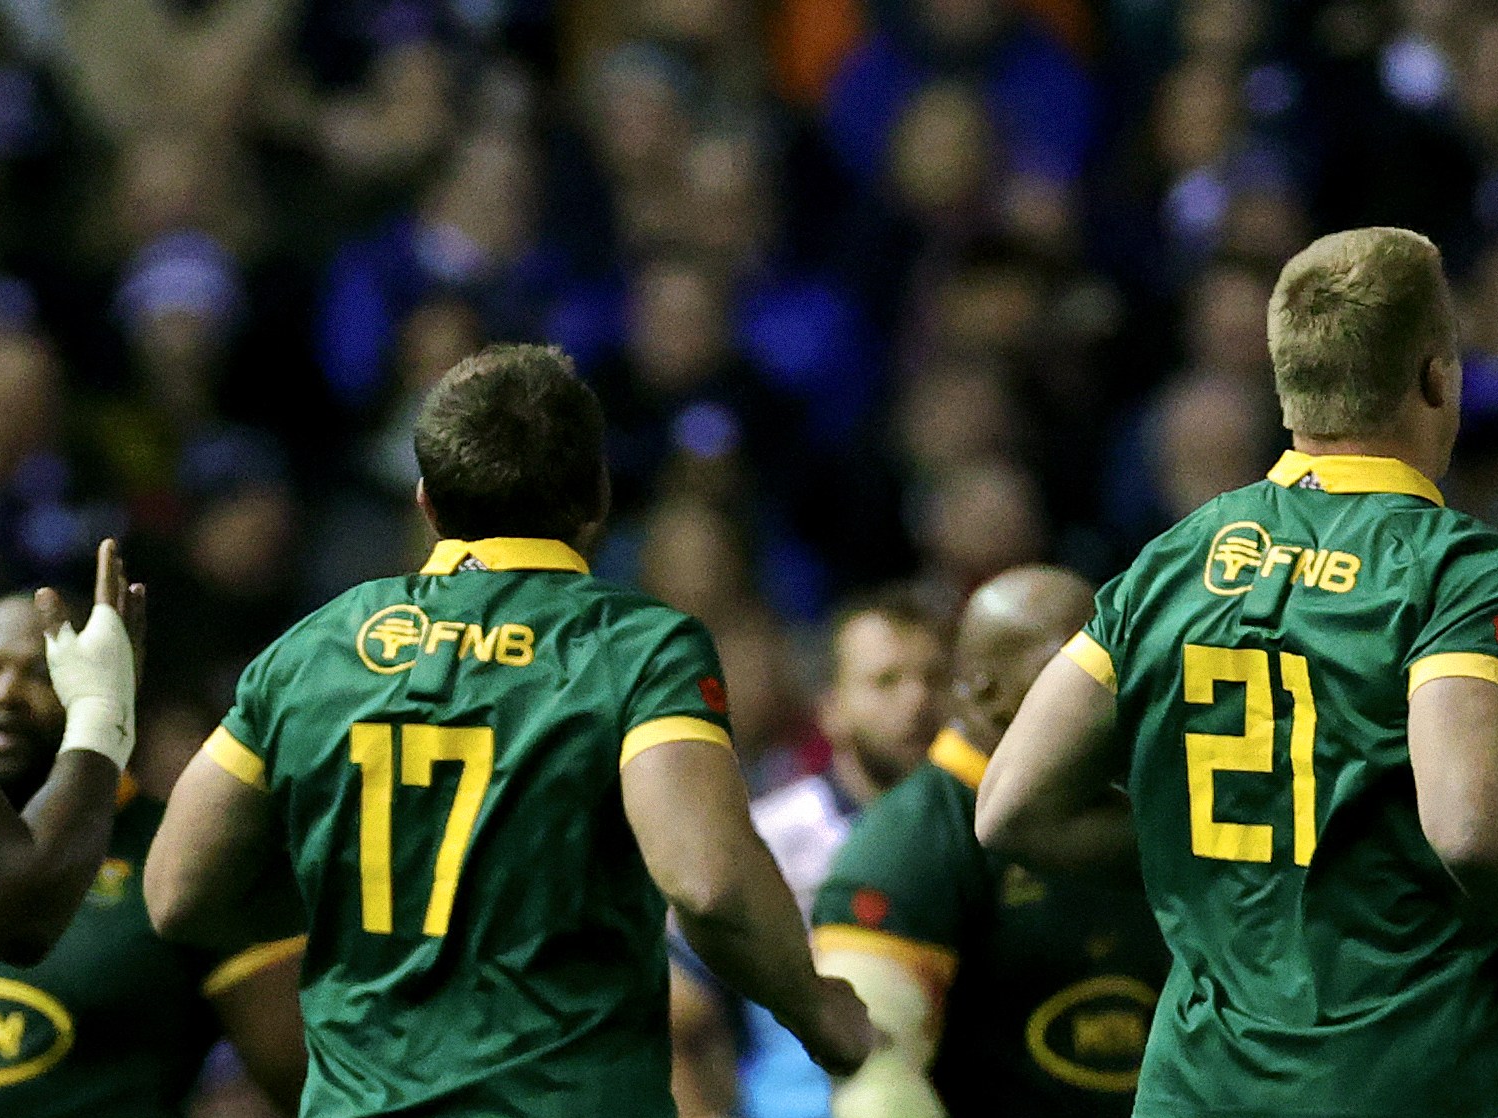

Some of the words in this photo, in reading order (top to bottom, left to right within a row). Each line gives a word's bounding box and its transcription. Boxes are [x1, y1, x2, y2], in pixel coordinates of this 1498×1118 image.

[1260, 545, 1362, 593] FNB
[424, 620, 535, 667] FNB
[1183, 643, 1317, 867] 21
[349, 722, 494, 937] 17
